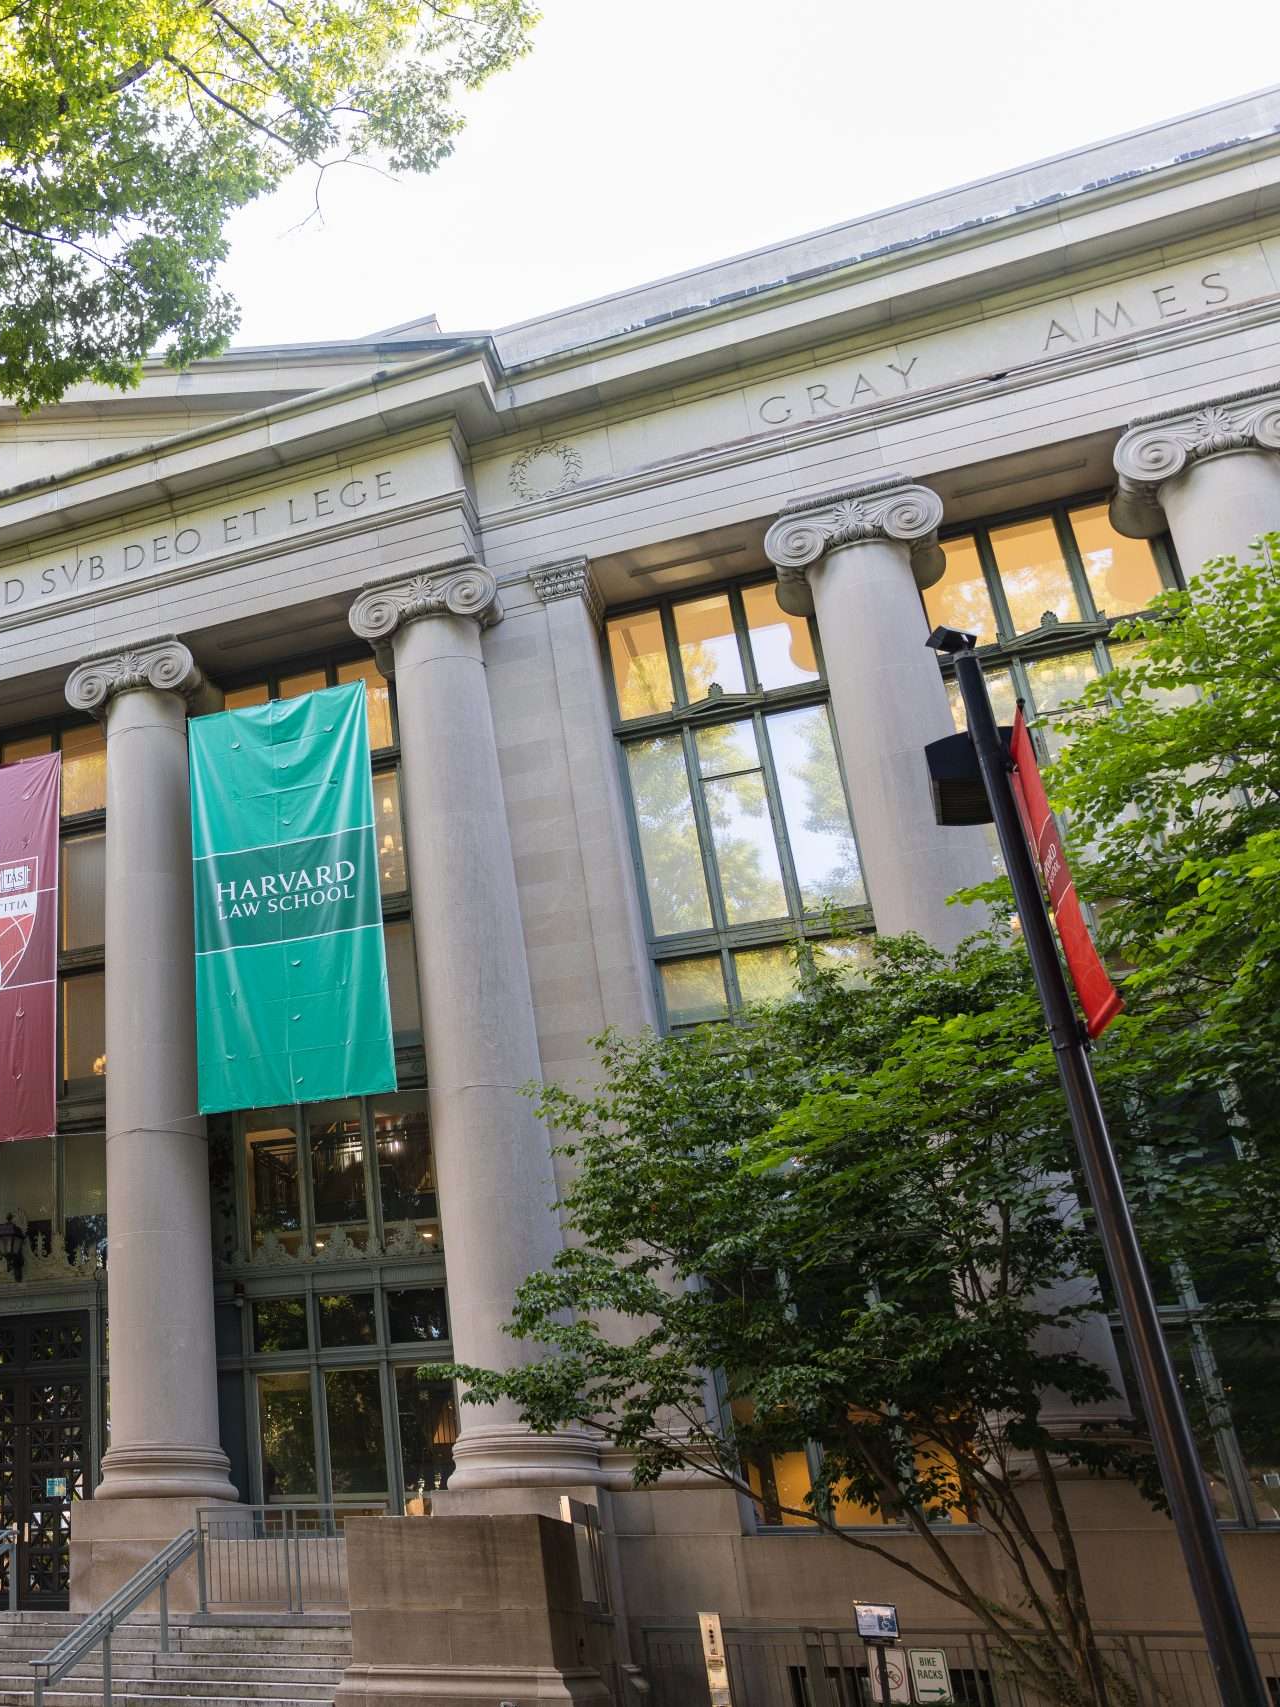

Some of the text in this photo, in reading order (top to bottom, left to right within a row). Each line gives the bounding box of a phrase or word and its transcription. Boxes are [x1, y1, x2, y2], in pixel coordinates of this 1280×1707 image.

[759, 272, 1230, 424] GRAY AMES
[40, 554, 105, 595] SVB
[123, 528, 201, 572] DEO
[223, 507, 267, 544] ET
[288, 471, 399, 525] LEGE
[216, 860, 356, 902] HARVARD
[218, 884, 356, 921] LAW SCHOOL
[917, 1669, 944, 1680] RACKS
[919, 1657, 937, 1667] BIKE
